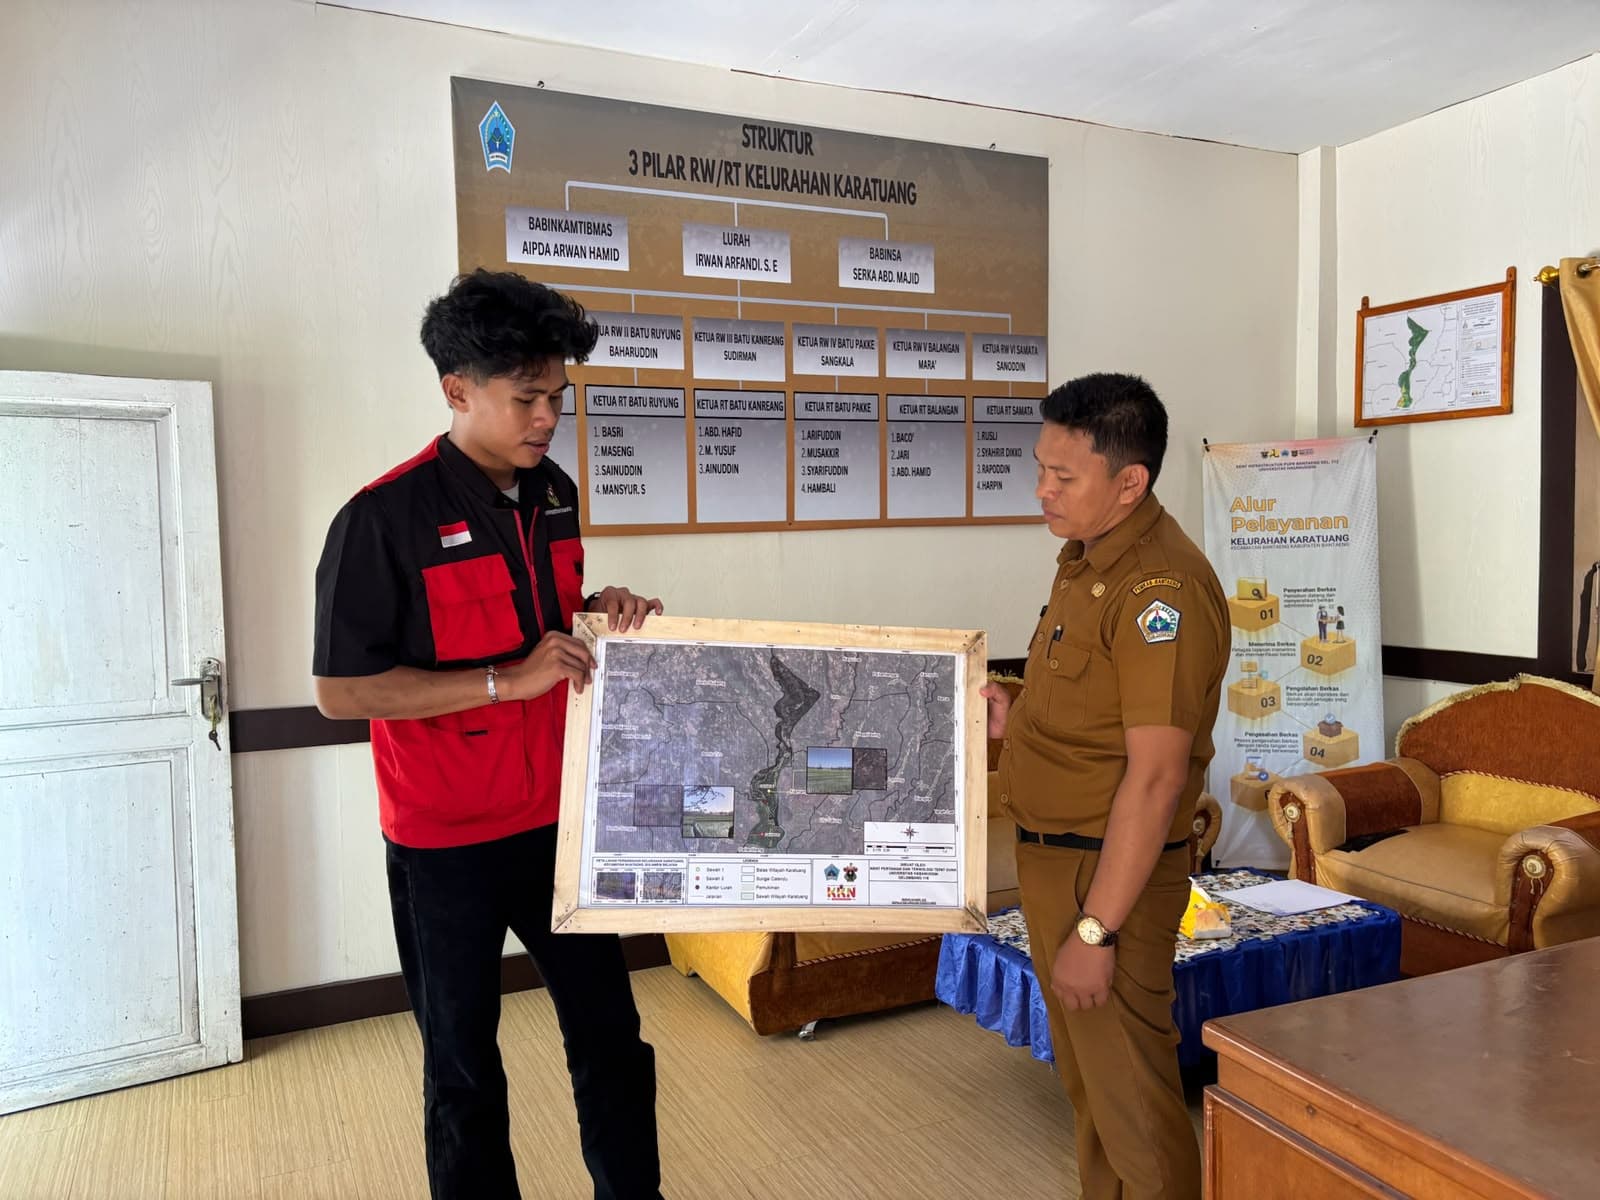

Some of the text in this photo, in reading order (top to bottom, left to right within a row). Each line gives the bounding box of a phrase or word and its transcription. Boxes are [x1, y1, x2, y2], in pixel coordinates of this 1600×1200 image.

[742, 124, 814, 156] STRUKTUR
[628, 150, 917, 206] 3 PILAR RW/RT KELURAHAN KARATUANG
[528, 216, 612, 237] BABINKAMTIBMAS
[722, 232, 750, 248] LURAH
[522, 240, 620, 262] AIPDA ARWAN HAMID
[869, 247, 902, 262] BABINSA
[695, 253, 723, 268] IRWAN
[852, 267, 920, 285] SERKA ABD. MAJID
[611, 326, 622, 337] RW
[624, 326, 629, 338] II
[630, 327, 650, 338] BATU
[651, 328, 680, 342] RUYUNG
[694, 332, 714, 342] KETUA
[716, 333, 726, 343] RW
[734, 334, 750, 344] BATU
[751, 335, 784, 346] KANREANG
[798, 336, 874, 350] KETUA RW IV BATU PAKKE
[893, 341, 960, 354] KETUA RW V BALANGAN
[609, 346, 658, 359] BAHARUDDIN
[982, 344, 1000, 354] KETUA
[1001, 344, 1009, 354] RW
[1017, 345, 1038, 355] SAMATA
[724, 350, 756, 362] SUDIRMAN
[821, 356, 854, 368] SANGKALA
[593, 395, 678, 408] KETUA RT BATU RUYUNG
[697, 400, 784, 412] KETUA RT BATU KANREANG
[804, 402, 871, 413] KETUA RT BATU PAKKE
[900, 404, 958, 416] KETUA RT BALANGAN
[986, 406, 1034, 416] KETUA RT SAMATA
[602, 426, 624, 437] BASRI
[722, 427, 742, 438] HAFID
[601, 446, 634, 457] MASENGI
[714, 445, 736, 456] YUSUF
[602, 465, 642, 476] SAINUDDIN
[912, 467, 931, 477] HAMID
[1230, 496, 1276, 512] Alur
[1232, 516, 1348, 534] Pelayanan
[1231, 534, 1350, 545] KELURAHAN KARATUANG
[1260, 608, 1274, 620] 01
[1307, 654, 1324, 666] 02
[1261, 696, 1276, 708] 03
[1310, 746, 1325, 758] 04
[827, 886, 856, 898] KKN
